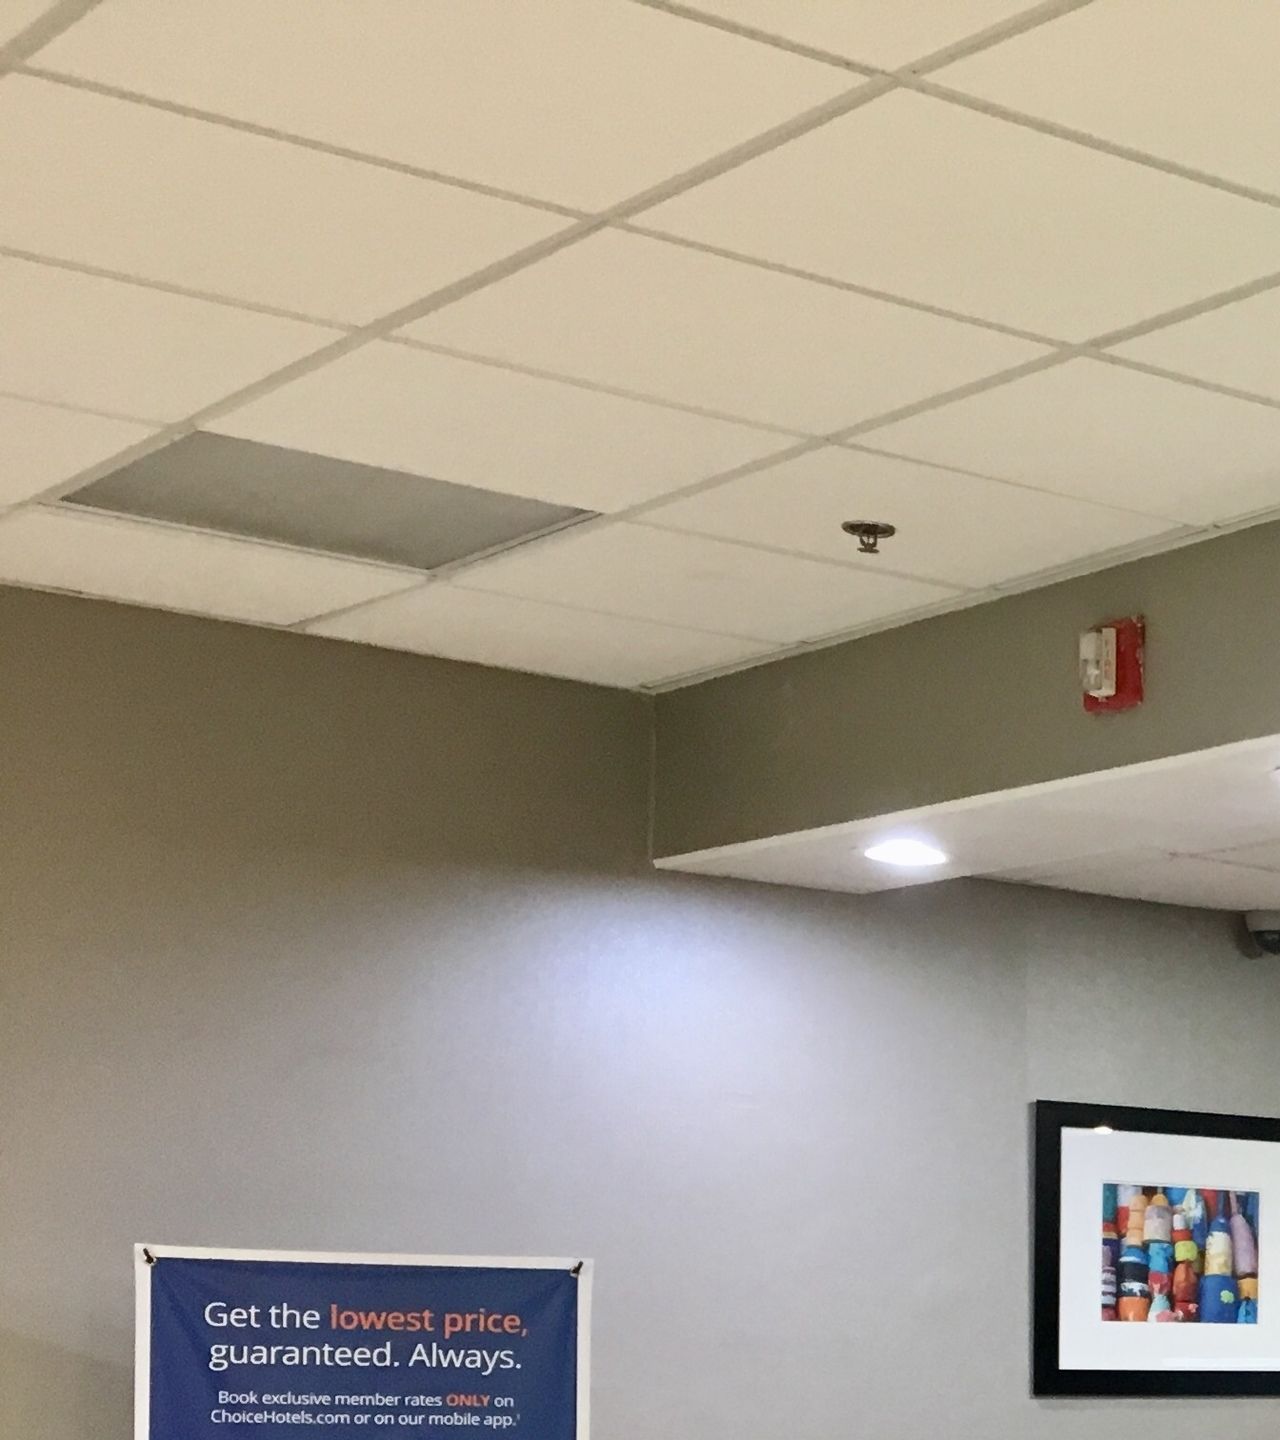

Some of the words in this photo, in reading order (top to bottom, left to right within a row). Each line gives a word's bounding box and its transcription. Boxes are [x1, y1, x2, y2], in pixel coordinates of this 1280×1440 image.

[204, 1301, 260, 1328] Get
[270, 1303, 320, 1328] the
[330, 1304, 434, 1332] lowest
[444, 1308, 528, 1338] price,
[209, 1342, 400, 1371] guaranteed.
[409, 1343, 522, 1375] Always.
[218, 1391, 258, 1405] Book
[262, 1391, 331, 1406] exclusive
[335, 1392, 401, 1406] member
[405, 1393, 442, 1406] rates
[446, 1394, 490, 1406] ONLY
[494, 1396, 514, 1407] on
[211, 1410, 350, 1425] ChoiceHotels.com
[354, 1413, 370, 1424] or
[374, 1414, 395, 1425] on
[399, 1414, 425, 1425] our
[429, 1411, 480, 1426] mobile
